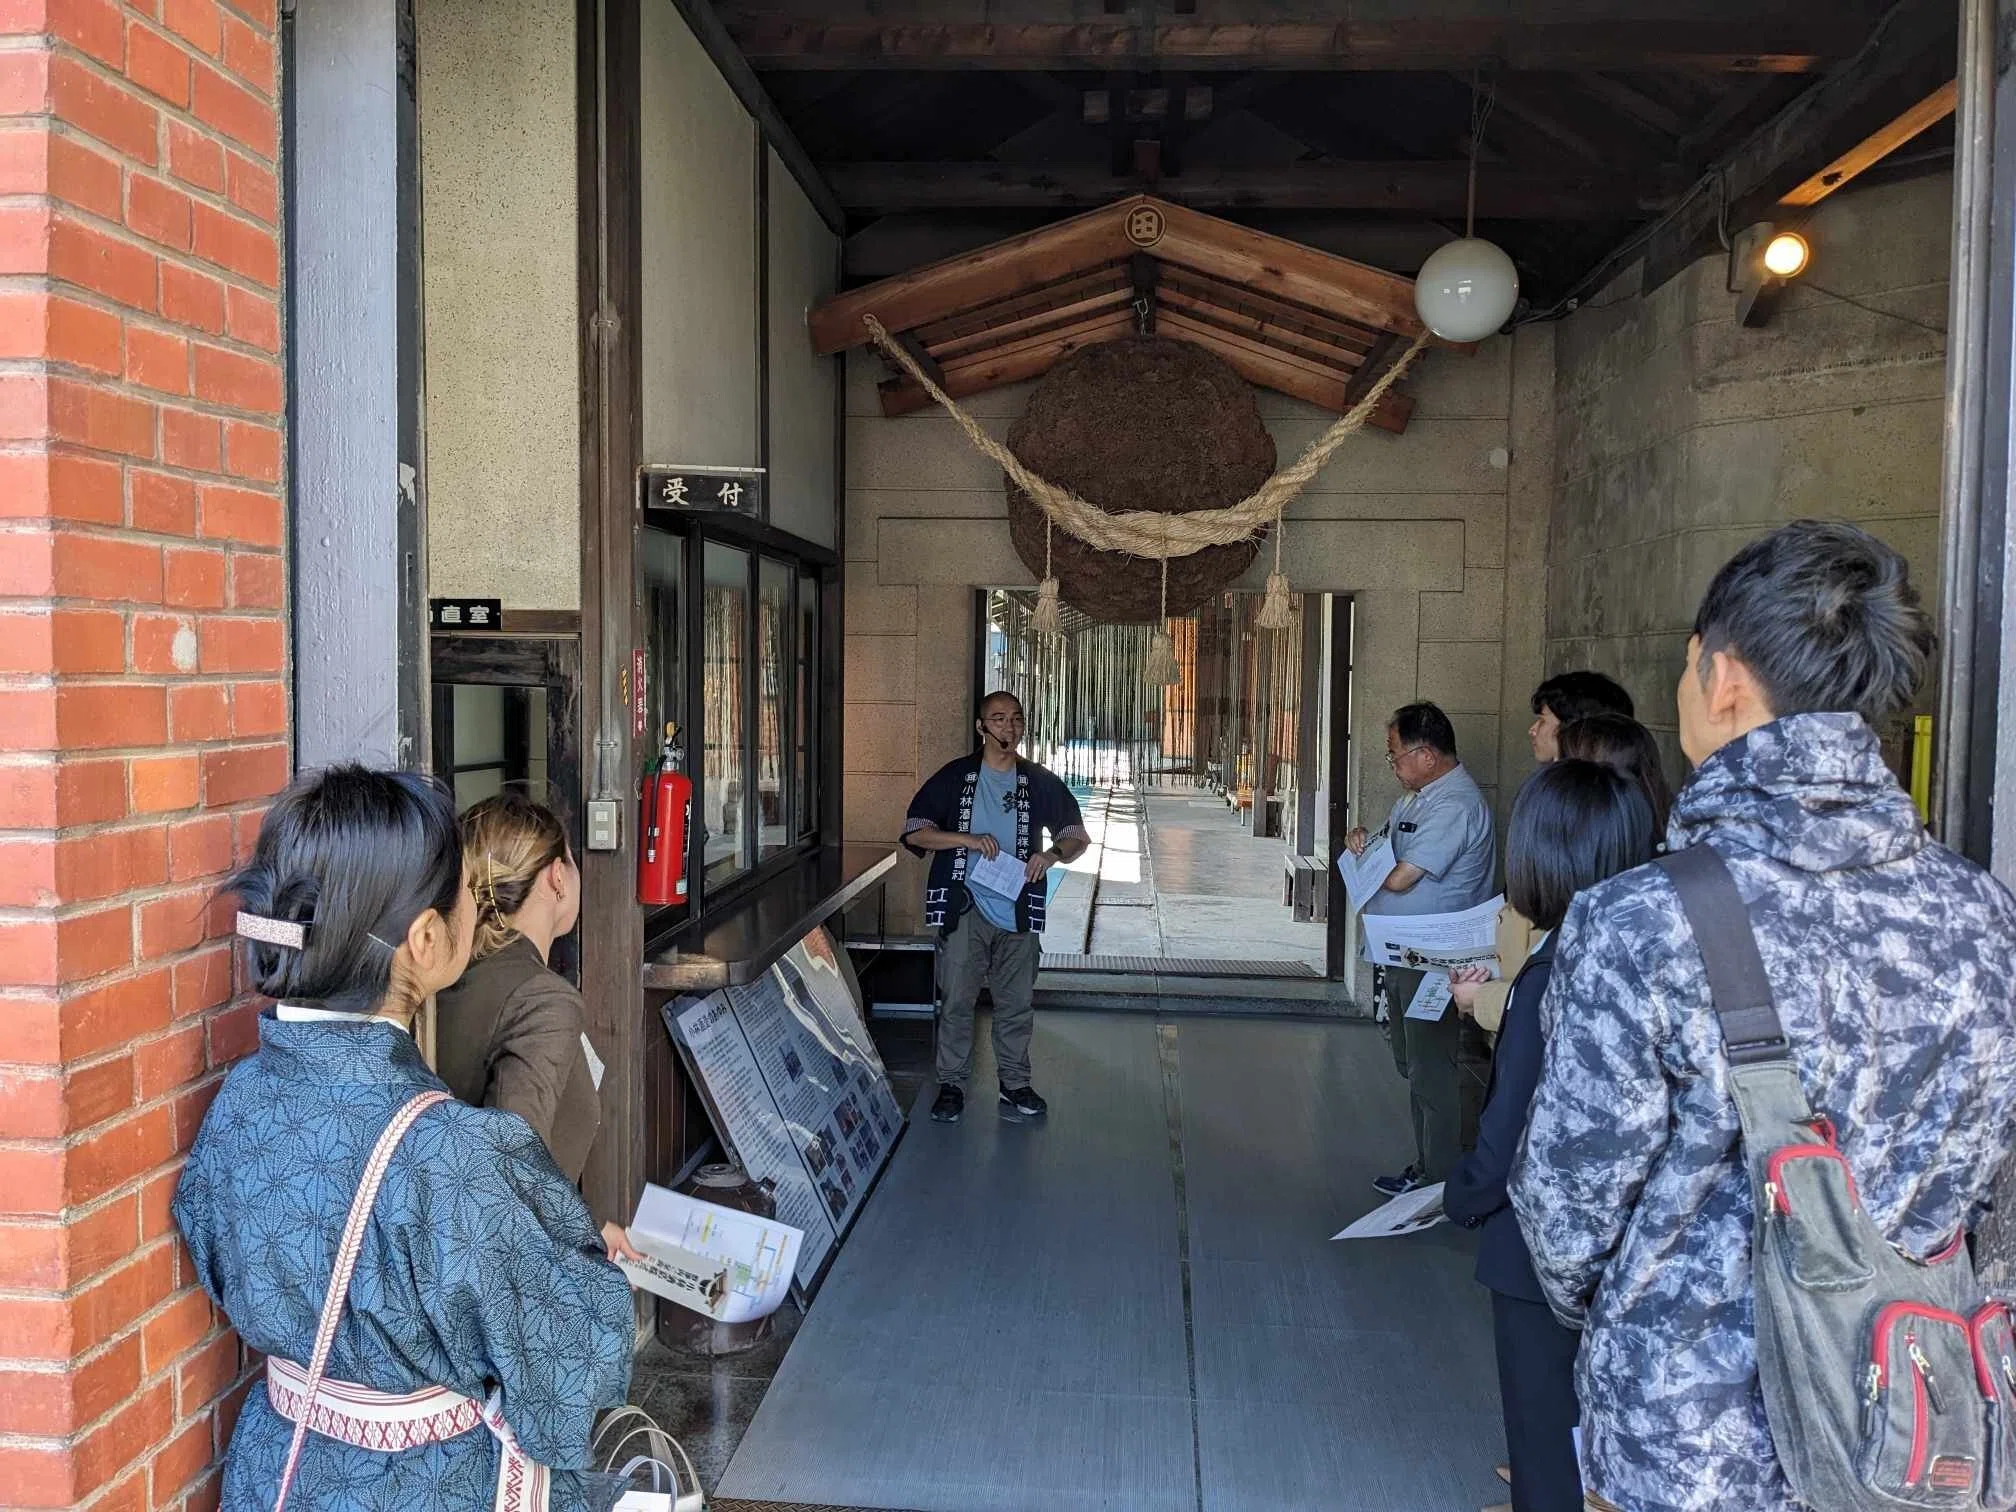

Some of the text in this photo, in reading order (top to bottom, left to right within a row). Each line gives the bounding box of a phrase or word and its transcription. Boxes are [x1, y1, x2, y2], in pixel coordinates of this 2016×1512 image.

[663, 477, 744, 507] 受付
[430, 604, 490, 623] 直室
[951, 785, 975, 881] 小林酒造式會社
